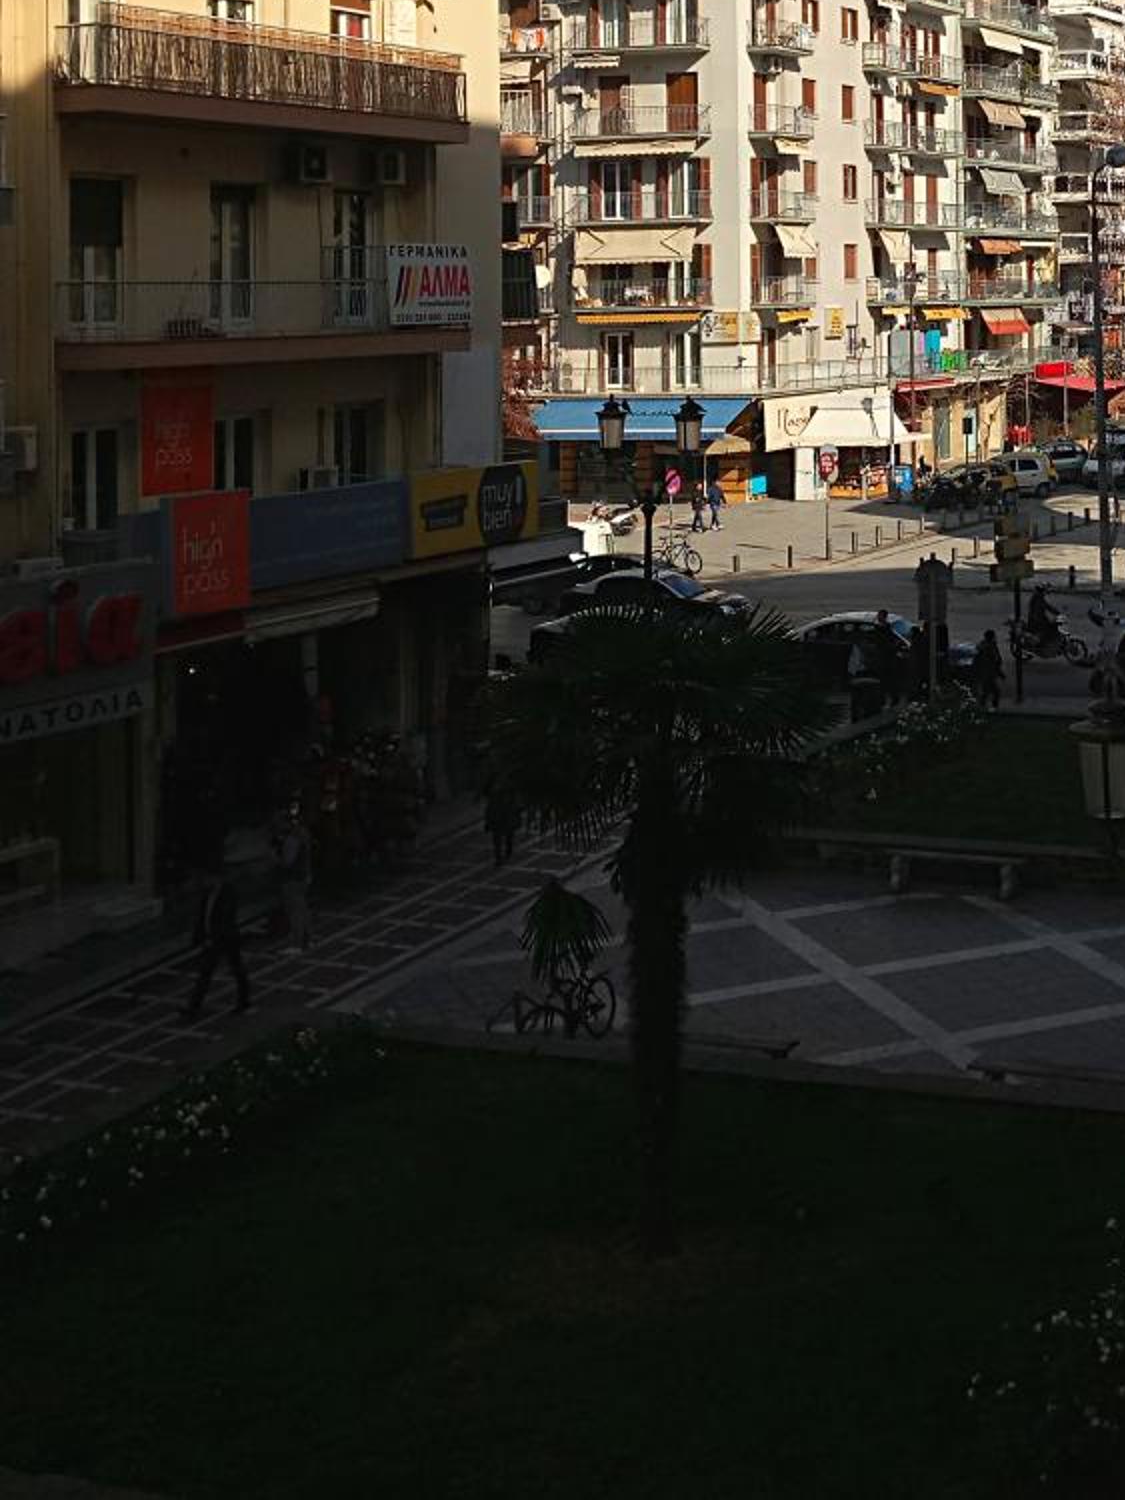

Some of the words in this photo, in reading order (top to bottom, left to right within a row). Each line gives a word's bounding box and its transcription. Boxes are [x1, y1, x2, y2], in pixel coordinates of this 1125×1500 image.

[389, 245, 467, 258] ΓΕΡΜΑΝΙΚΑ
[419, 264, 470, 297] ΑΛΜΑ
[482, 484, 513, 508] muy
[184, 568, 231, 598] pass
